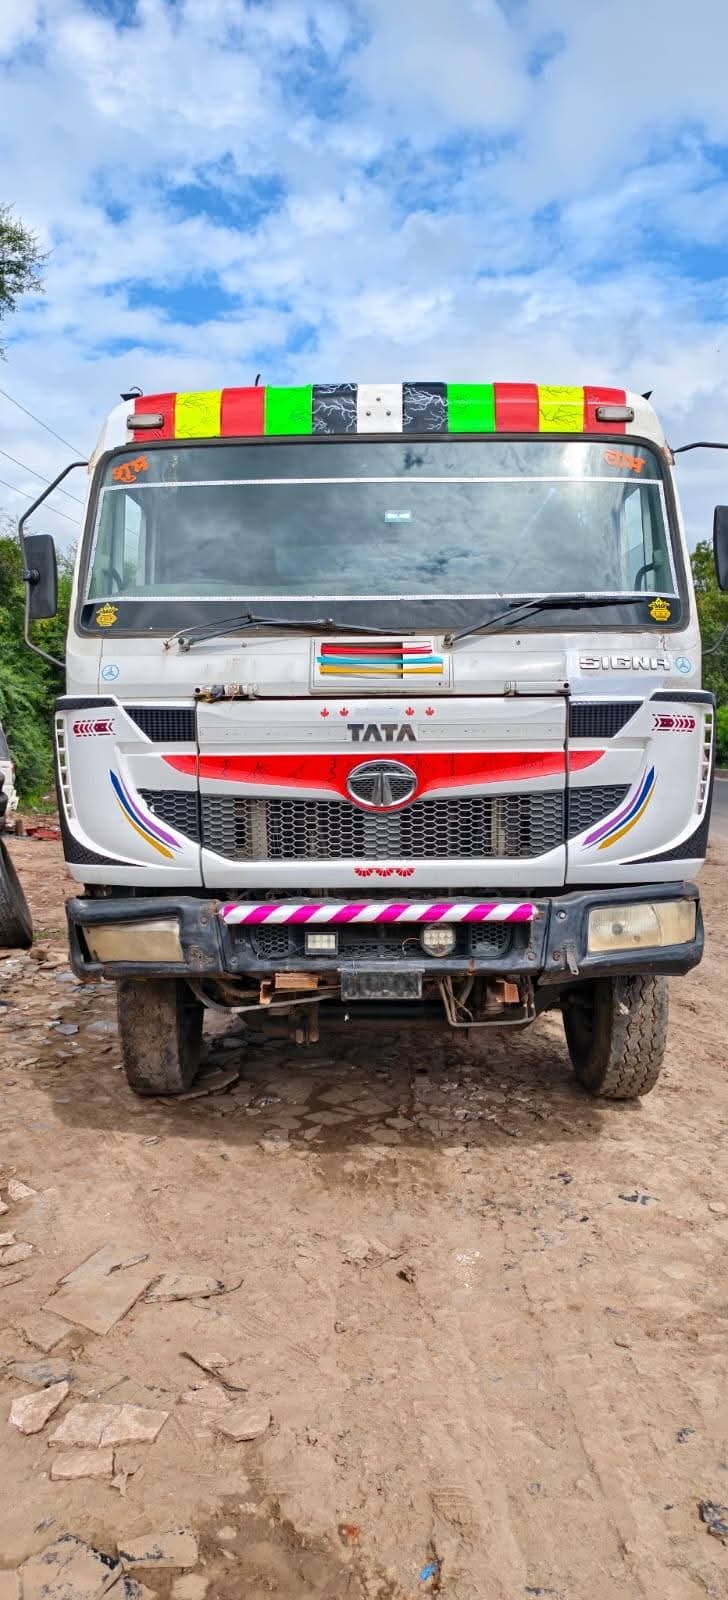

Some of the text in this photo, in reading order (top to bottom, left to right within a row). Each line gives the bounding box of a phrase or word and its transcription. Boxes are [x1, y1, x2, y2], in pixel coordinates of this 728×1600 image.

[112, 455, 149, 482] शुभ
[579, 655, 671, 671] SIGNA
[347, 724, 417, 741] TATA
